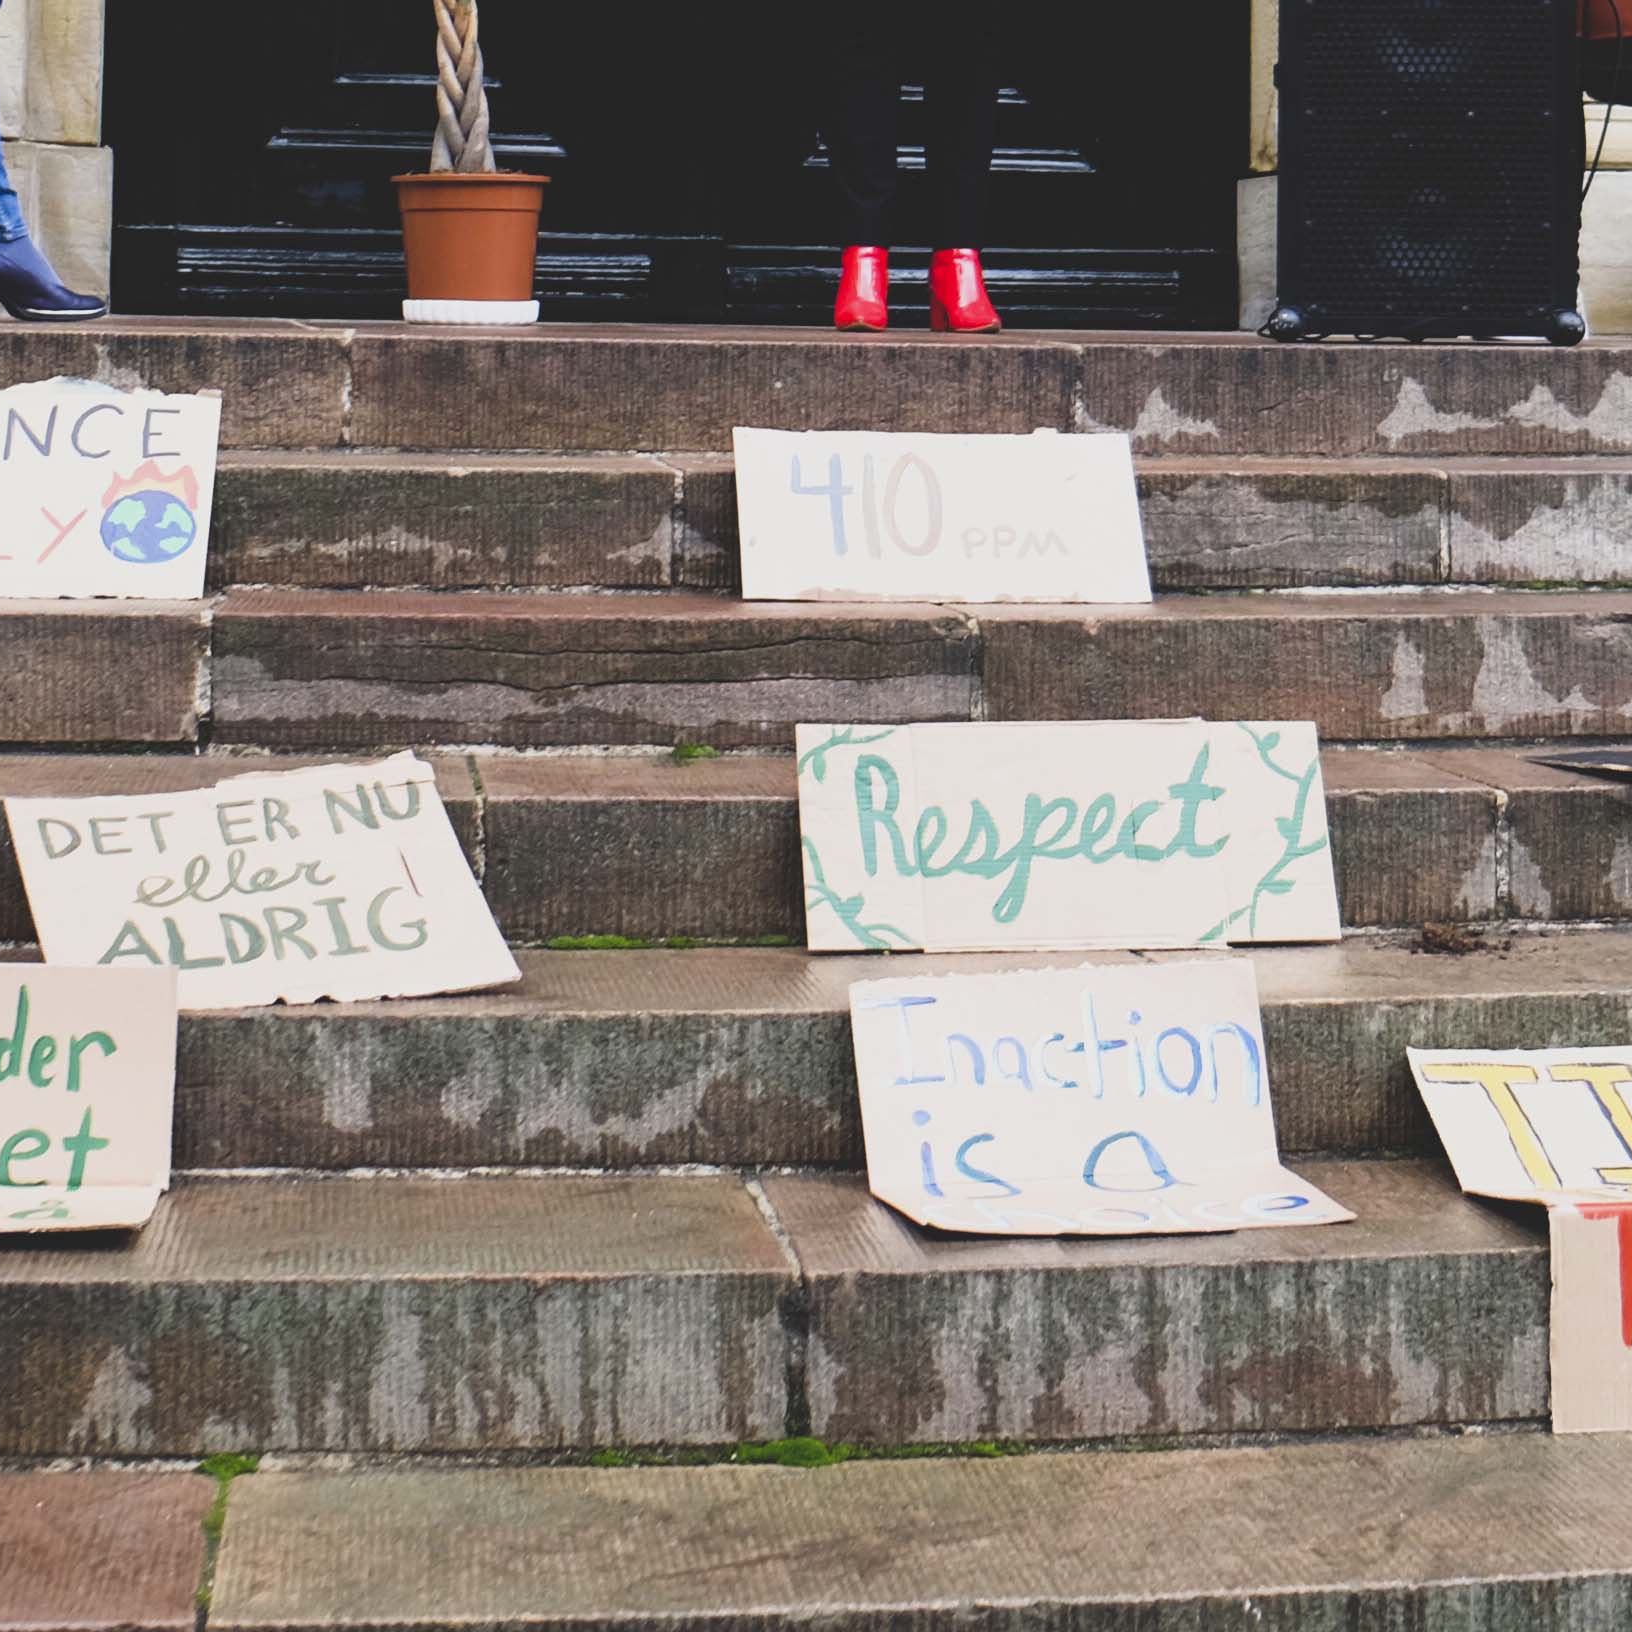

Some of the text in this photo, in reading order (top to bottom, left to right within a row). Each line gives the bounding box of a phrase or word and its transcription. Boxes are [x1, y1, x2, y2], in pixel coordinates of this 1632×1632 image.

[791, 451, 943, 560] 410
[36, 779, 422, 860] DET ER NU
[854, 741, 1232, 923] Respect
[132, 847, 337, 908] eller
[855, 987, 1261, 1107] Inaction
[911, 1110, 1023, 1200] is
